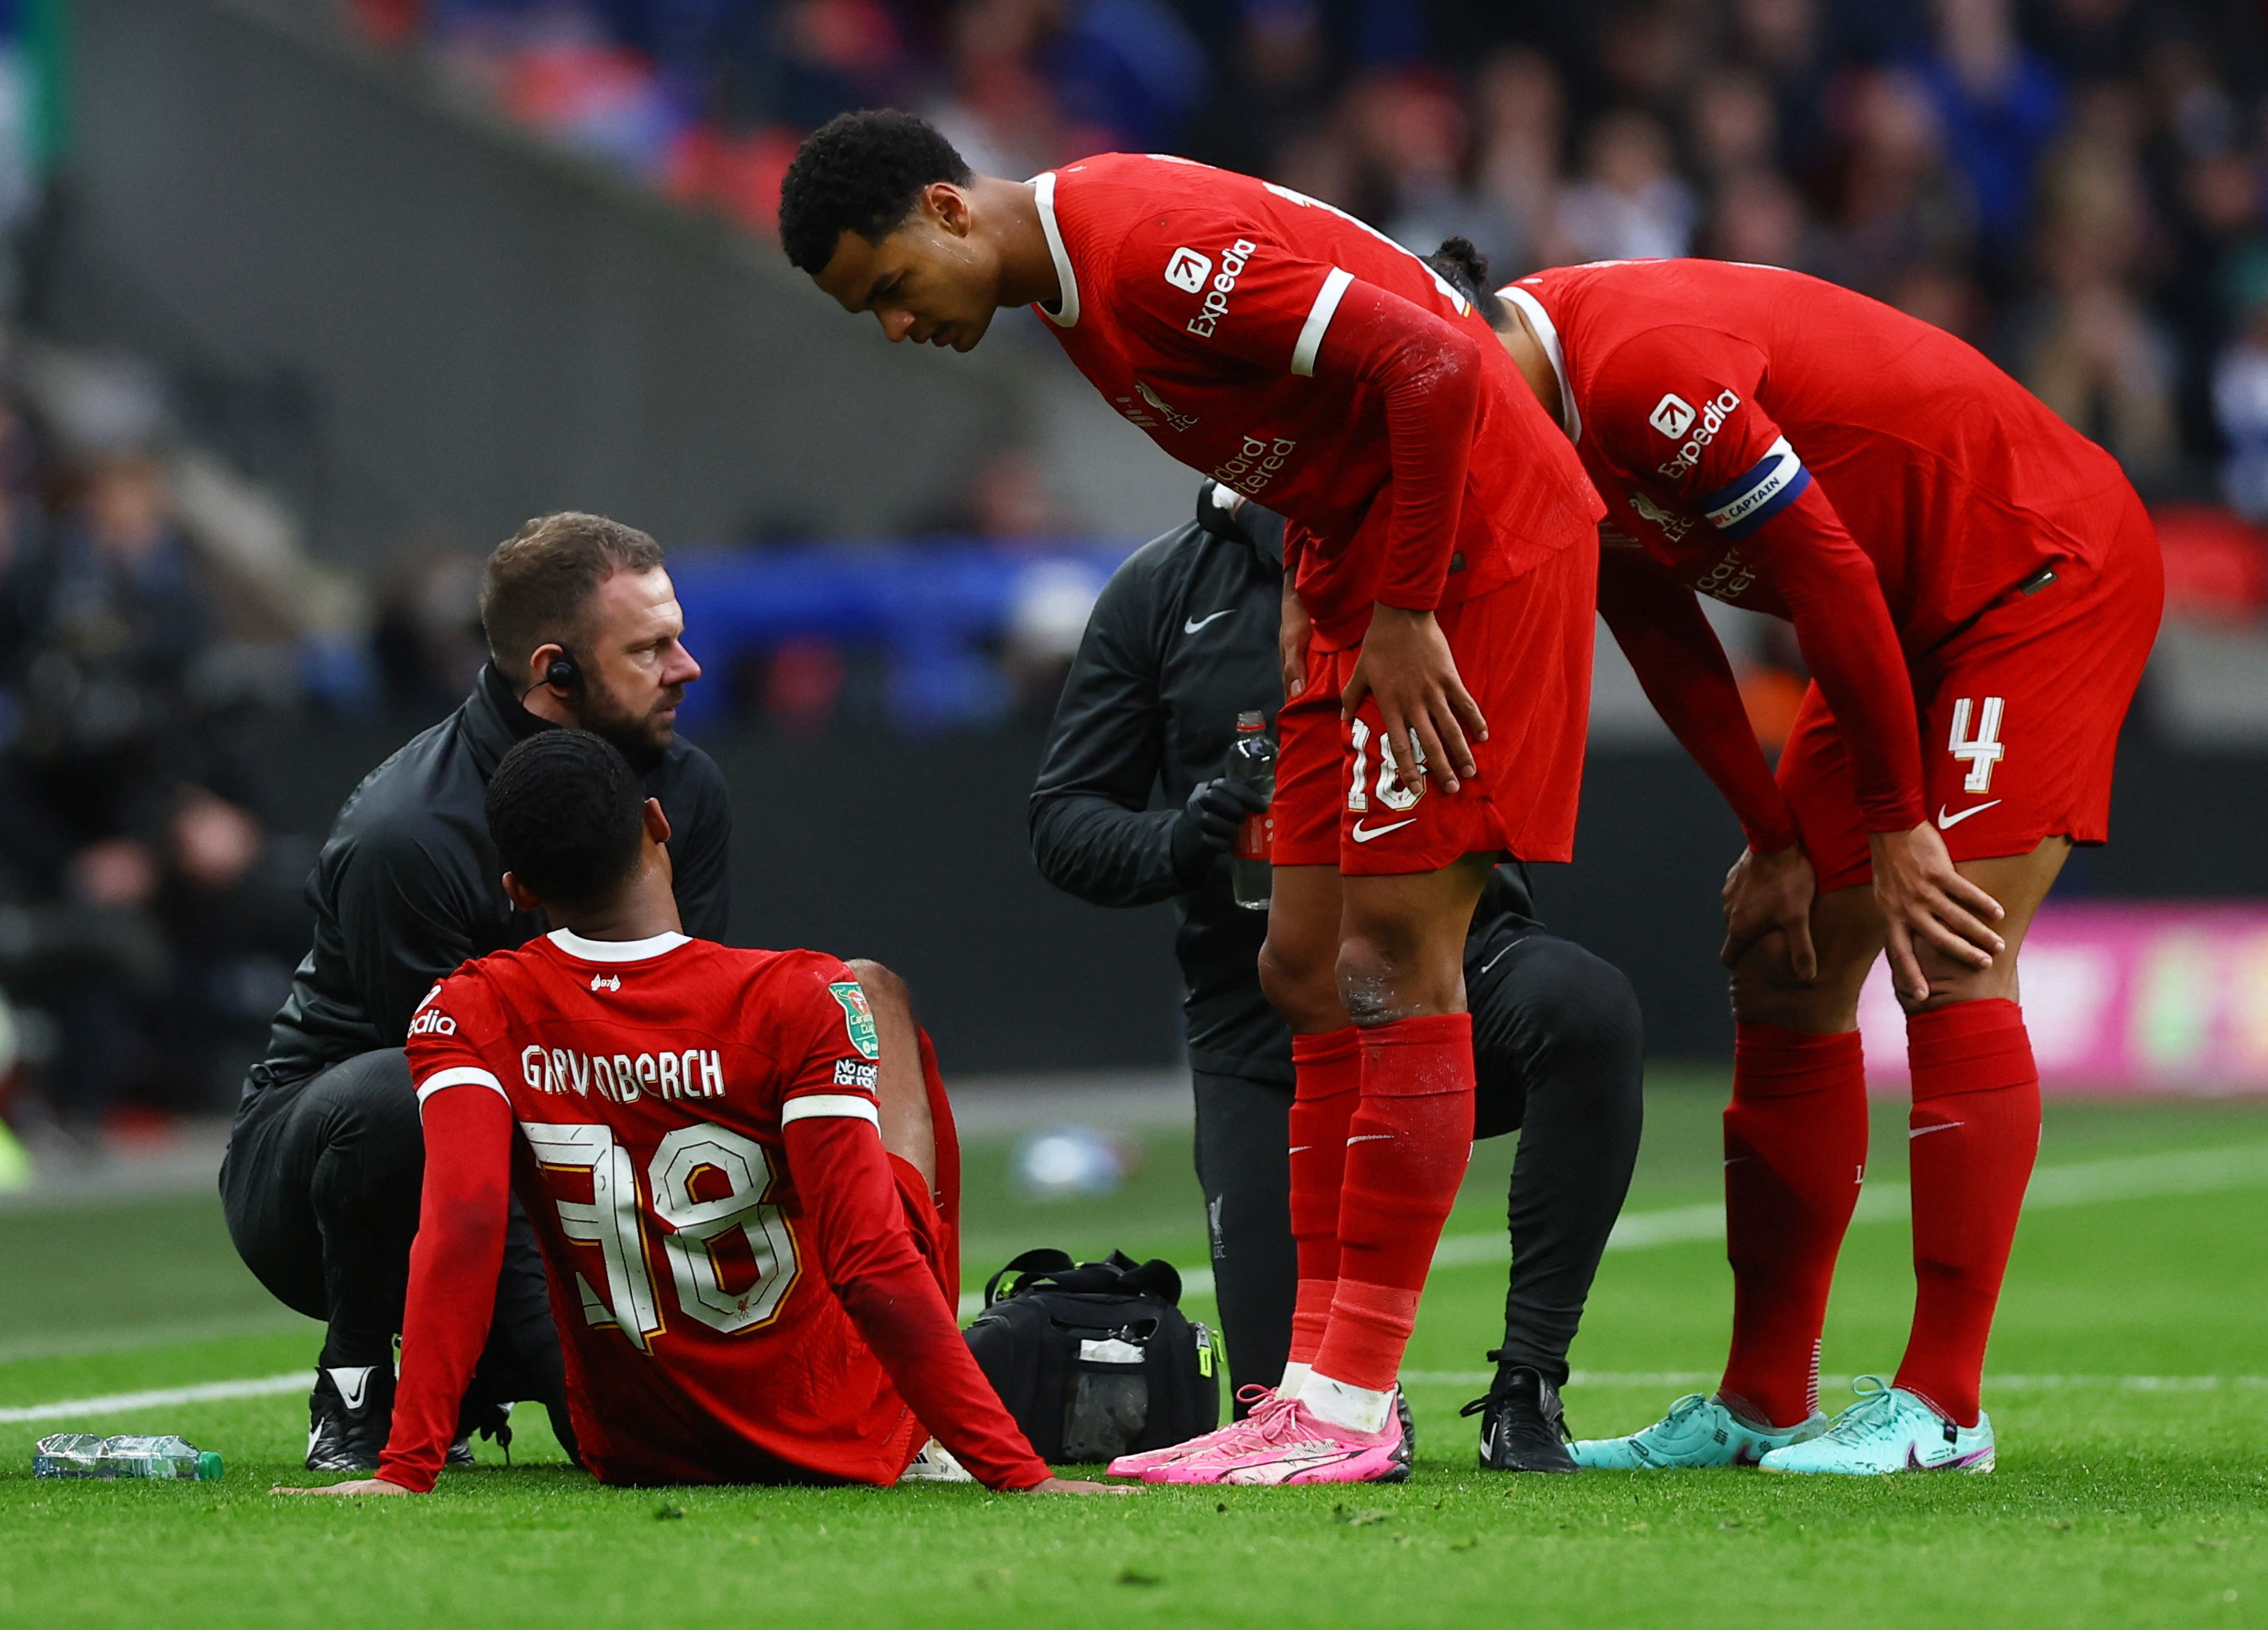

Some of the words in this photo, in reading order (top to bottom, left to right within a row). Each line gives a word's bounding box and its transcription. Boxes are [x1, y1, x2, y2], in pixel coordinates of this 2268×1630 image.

[1187, 238, 1257, 338] Expedia
[1658, 389, 1740, 479] Expedia
[1728, 476, 1780, 517] CAPTAIN
[1348, 717, 1427, 812] 18
[1948, 696, 2005, 793] 4
[836, 1059, 857, 1074] No
